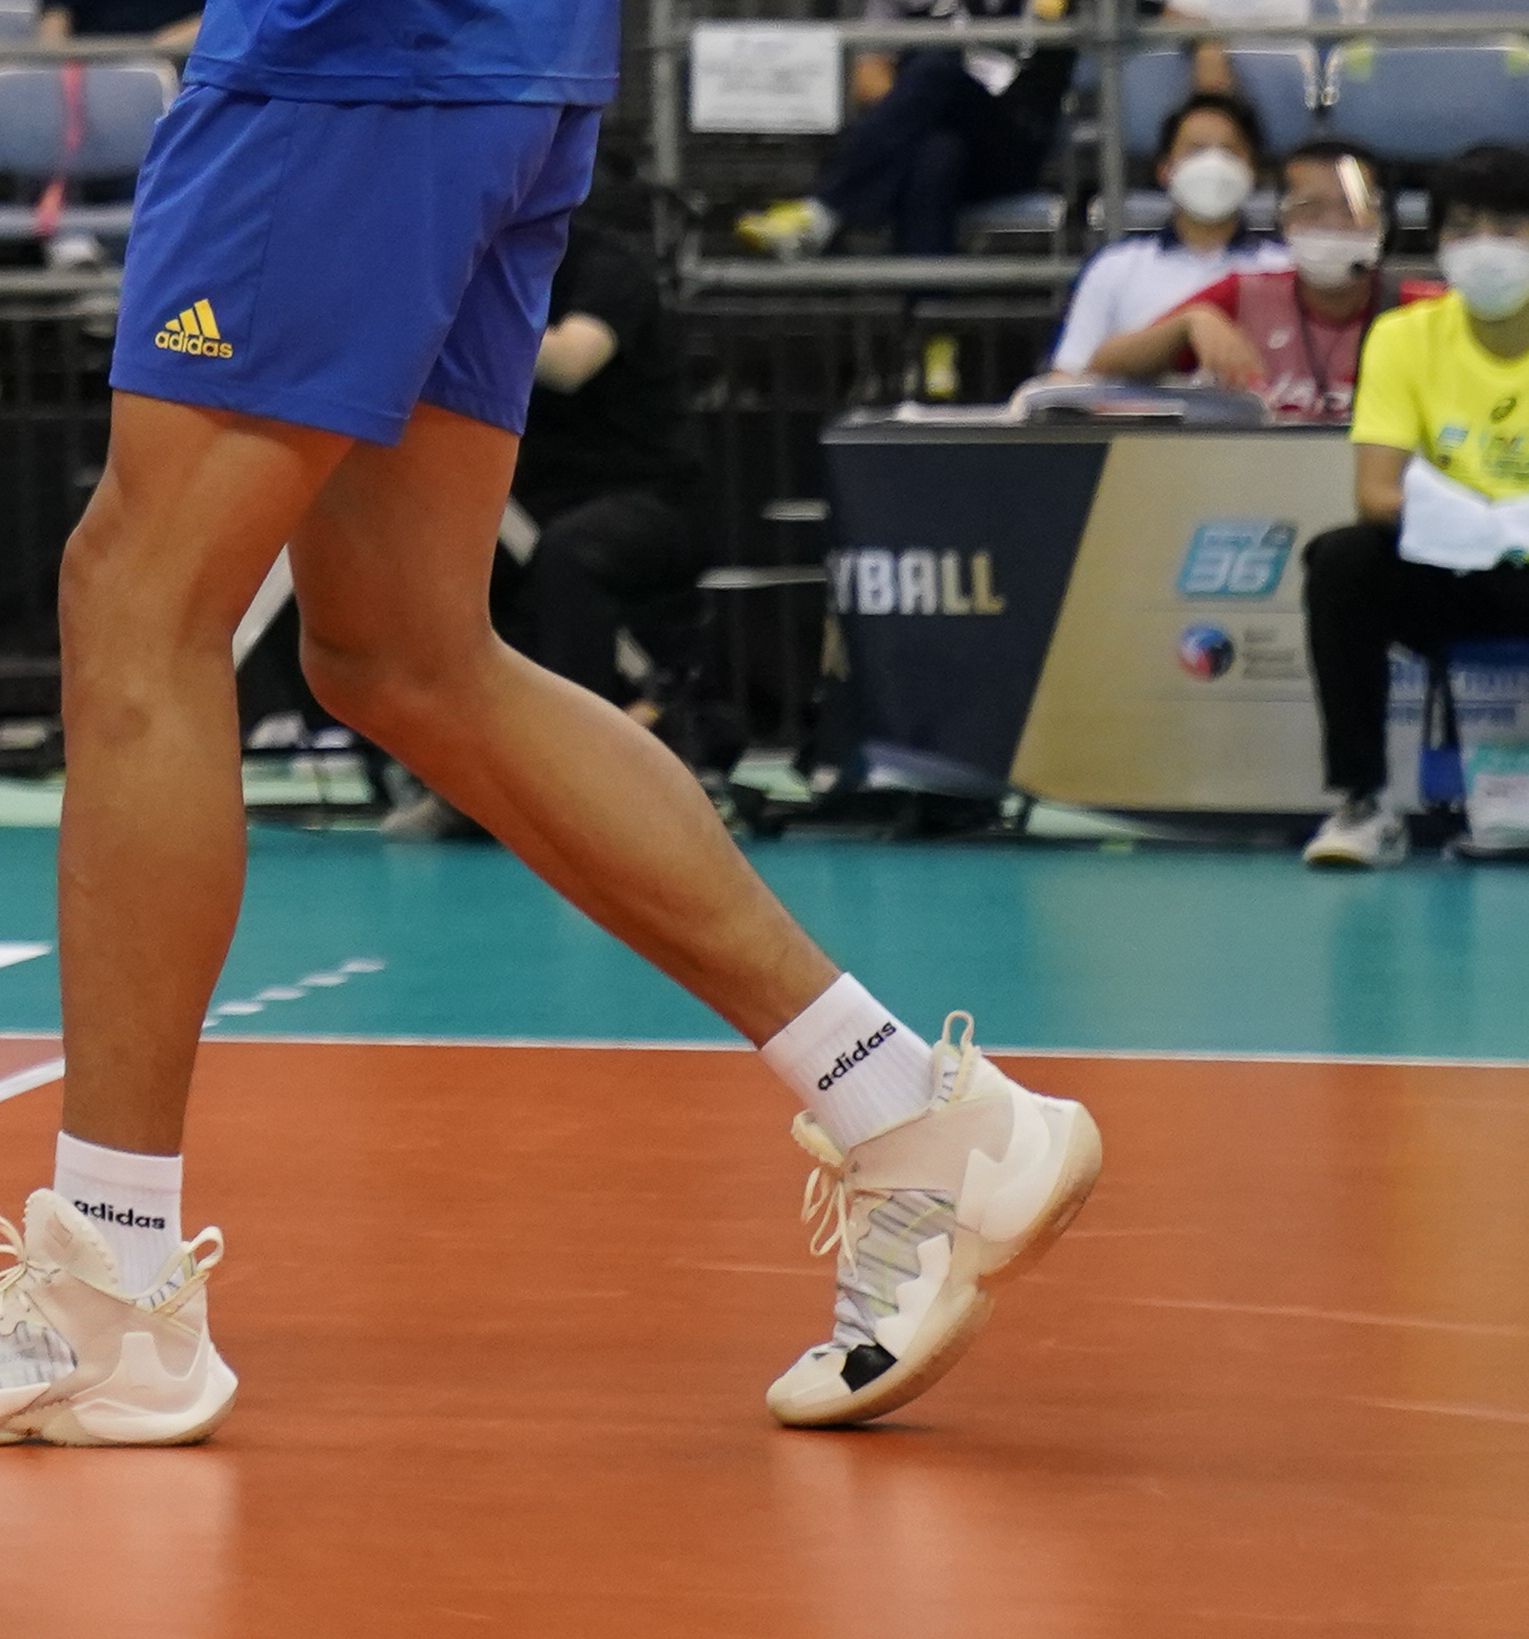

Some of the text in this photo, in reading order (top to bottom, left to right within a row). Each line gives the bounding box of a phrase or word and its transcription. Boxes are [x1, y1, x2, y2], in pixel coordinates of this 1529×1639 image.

[154, 330, 234, 359] adidas
[816, 1020, 898, 1092] adidas
[73, 1199, 167, 1231] adidas
